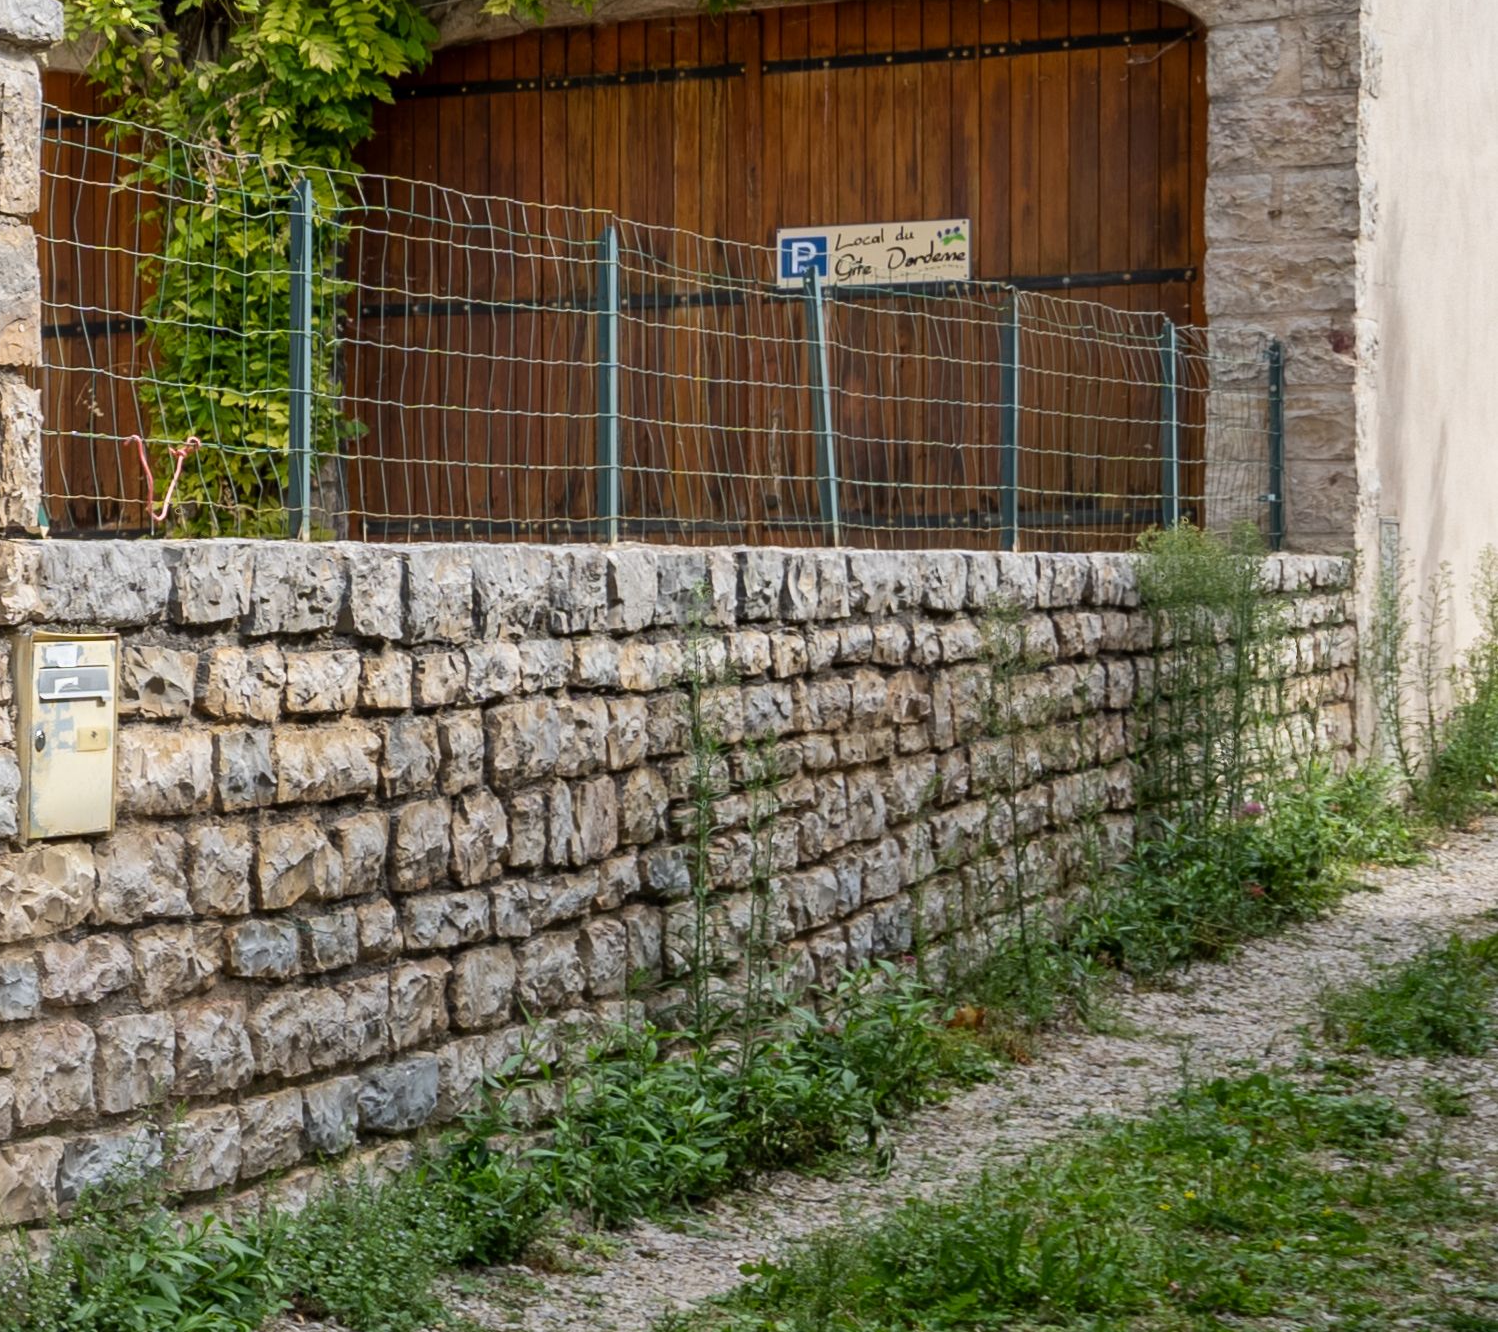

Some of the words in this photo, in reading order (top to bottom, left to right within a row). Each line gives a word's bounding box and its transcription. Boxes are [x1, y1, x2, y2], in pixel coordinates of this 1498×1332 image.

[835, 227, 884, 251] Local
[895, 225, 914, 241] du
[791, 241, 817, 274] P
